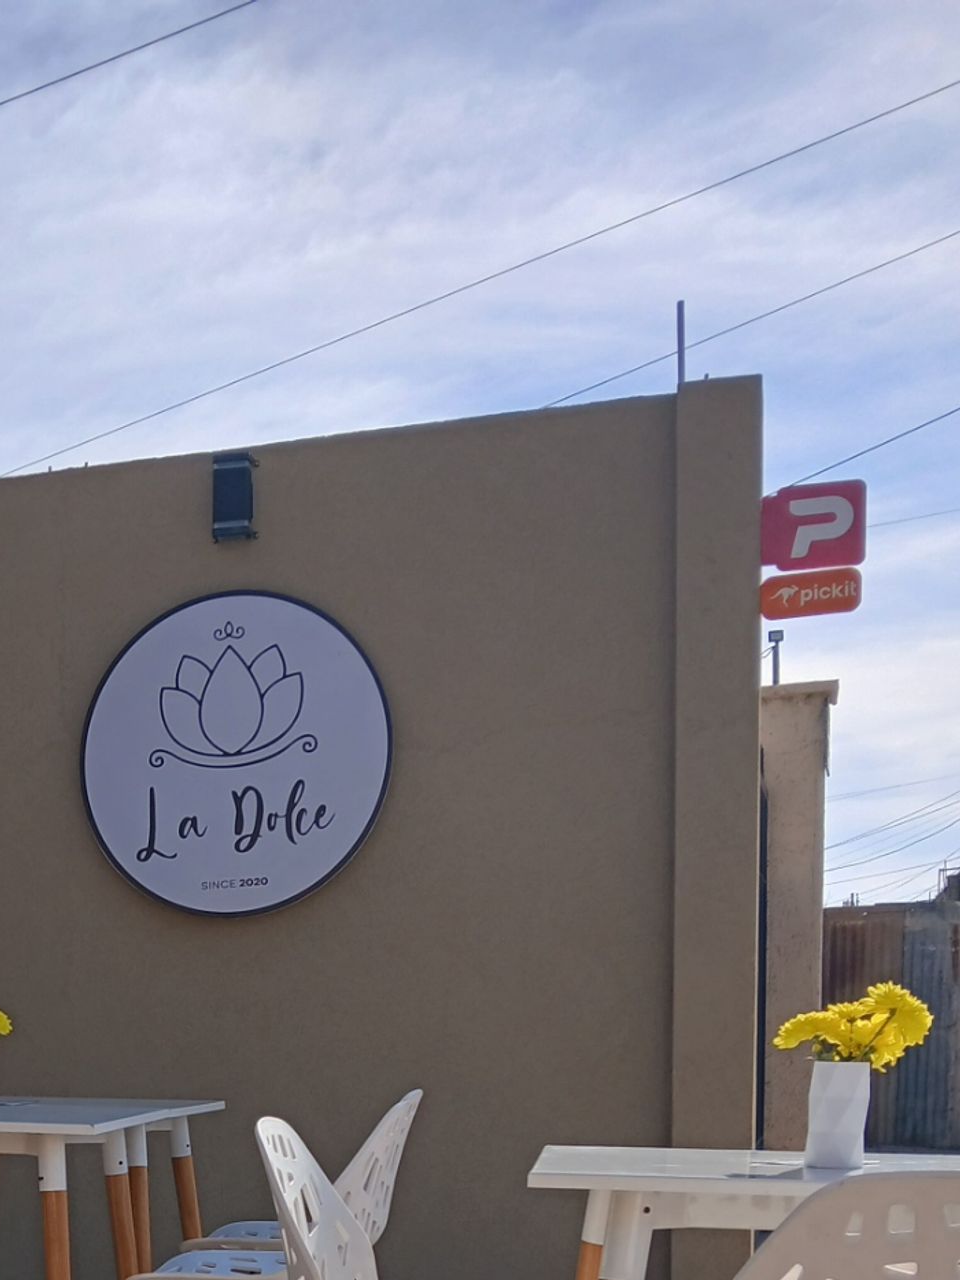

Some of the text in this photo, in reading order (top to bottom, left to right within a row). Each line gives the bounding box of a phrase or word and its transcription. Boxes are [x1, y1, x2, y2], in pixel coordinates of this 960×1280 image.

[800, 581, 858, 607] pickit
[136, 779, 336, 862] La Dolce
[201, 877, 268, 890] SINCE 2020
